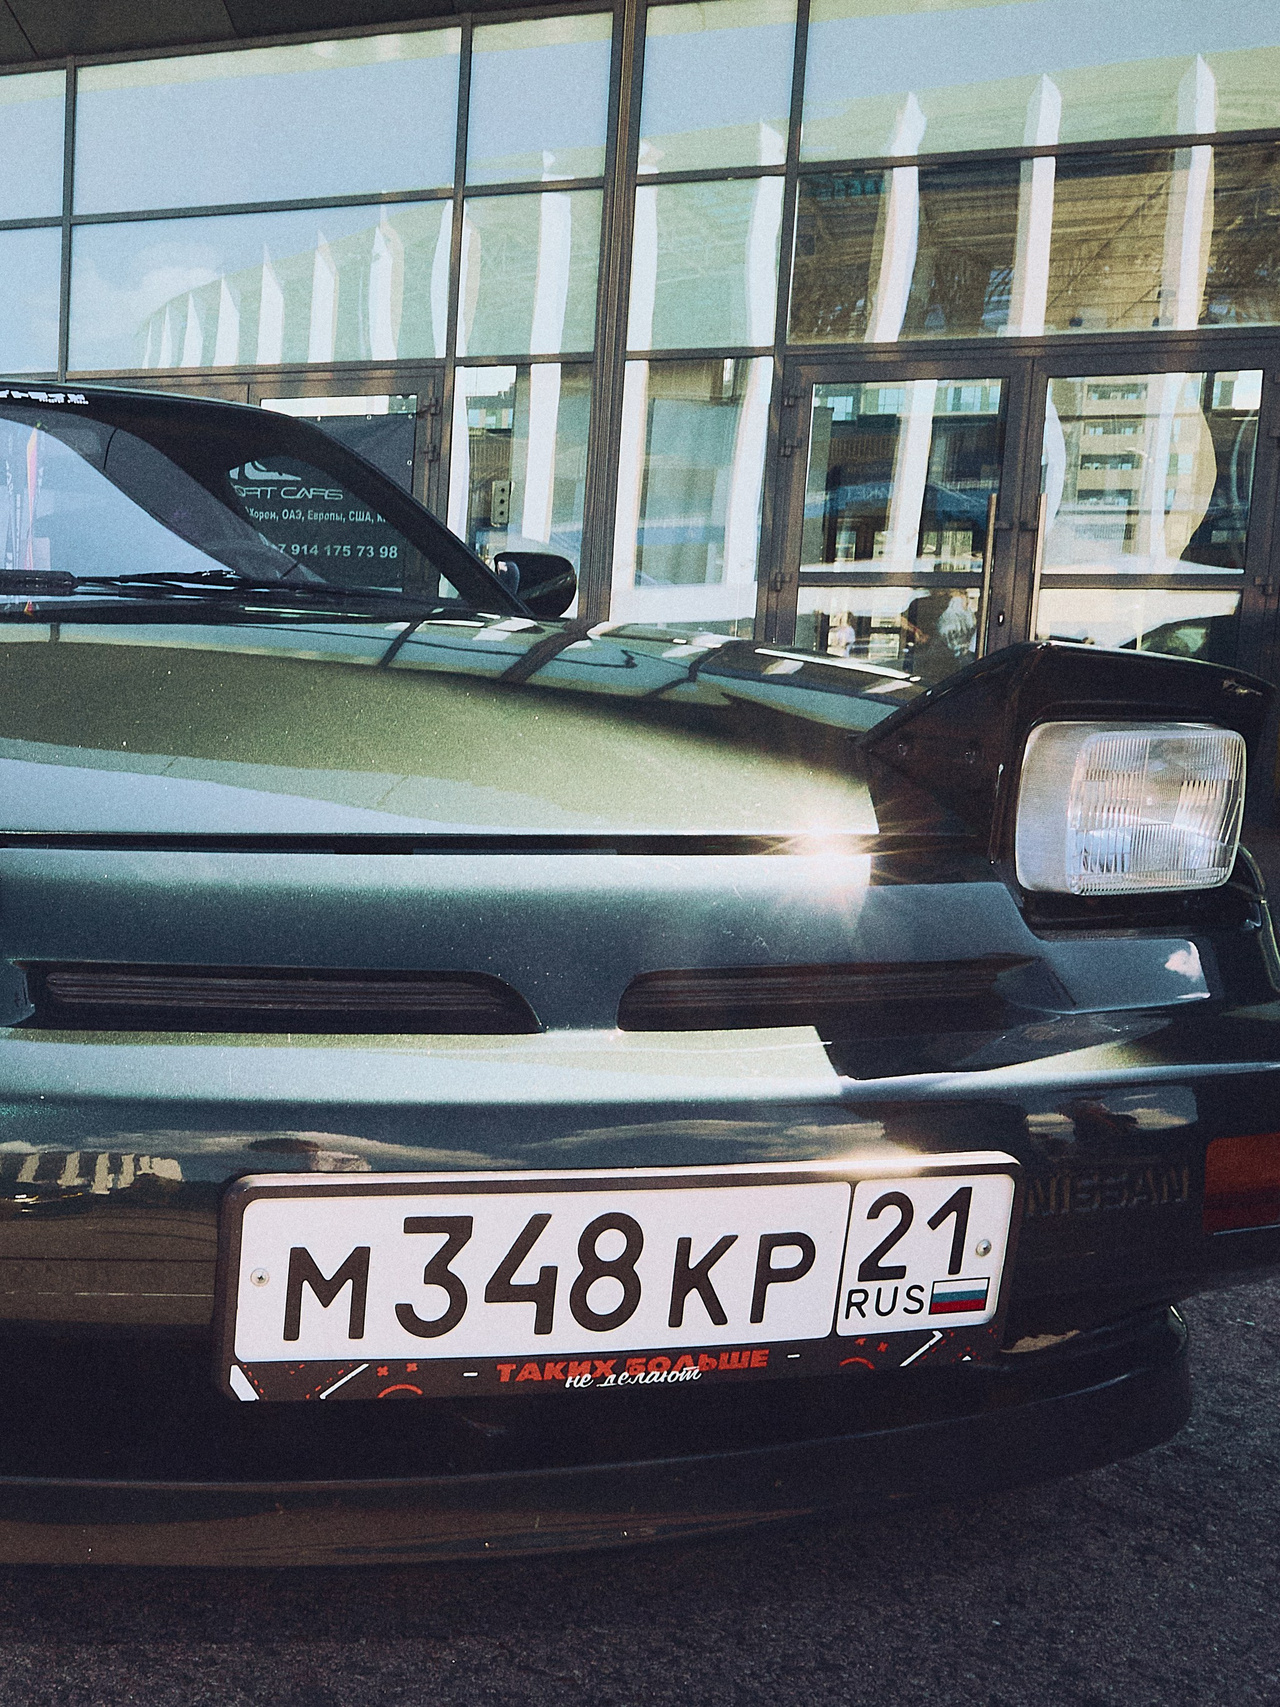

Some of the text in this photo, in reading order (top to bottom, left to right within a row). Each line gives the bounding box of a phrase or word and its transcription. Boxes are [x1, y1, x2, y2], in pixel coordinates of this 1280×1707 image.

[280, 486, 344, 500] CARS
[348, 510, 374, 525] США,
[291, 543, 318, 556] 914
[324, 544, 352, 557] 175
[356, 545, 375, 557] 73
[379, 545, 398, 559] 98
[1024, 1165, 1190, 1218] NISSAN
[857, 1186, 973, 1283] 21
[844, 1284, 926, 1320] RUS
[496, 1349, 771, 1383] ТАКИХ БОЛЬШЕ
[564, 1364, 703, 1388] не делают
